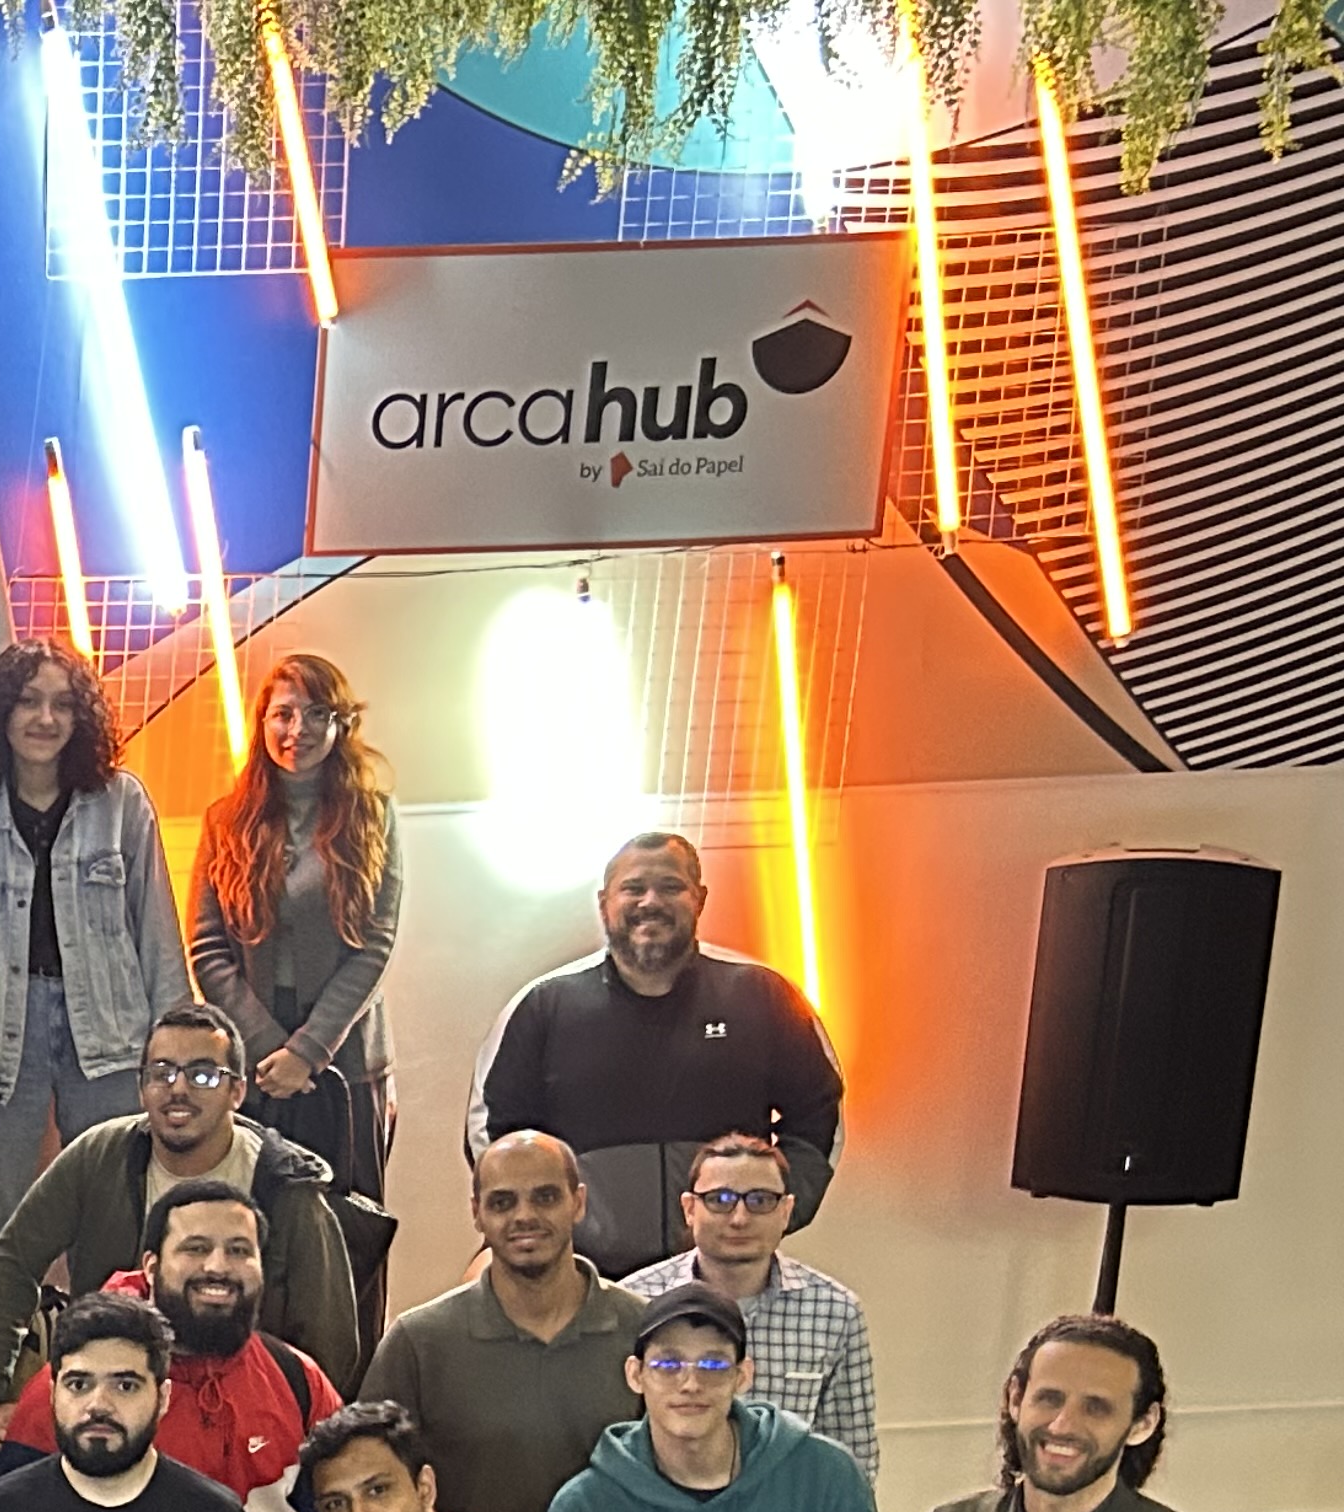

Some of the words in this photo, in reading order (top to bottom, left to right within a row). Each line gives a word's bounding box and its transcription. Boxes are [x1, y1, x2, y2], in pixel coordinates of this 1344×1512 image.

[371, 357, 749, 450] arcahub
[579, 462, 603, 483] by
[636, 459, 664, 478] Sai
[668, 458, 692, 476] do
[695, 454, 744, 477] Papel
